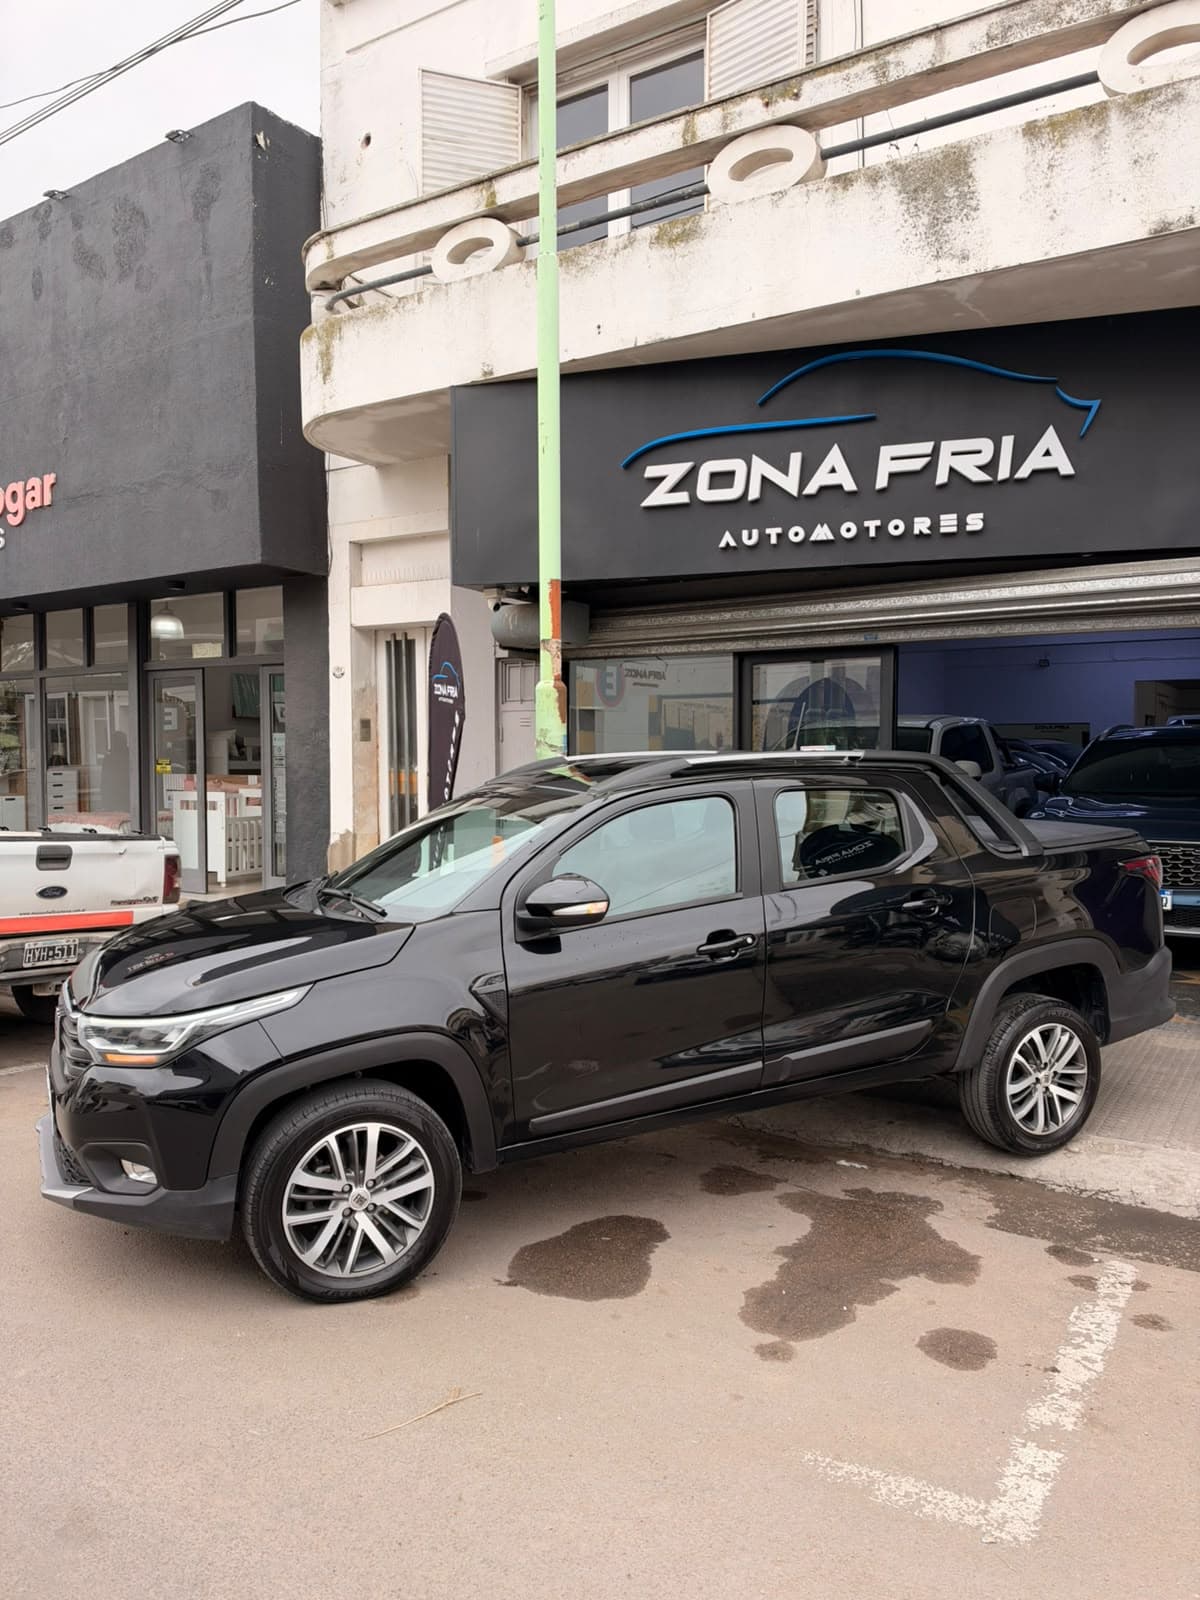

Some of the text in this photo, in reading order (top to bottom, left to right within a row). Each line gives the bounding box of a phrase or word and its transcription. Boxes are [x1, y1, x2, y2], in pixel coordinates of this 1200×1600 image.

[640, 424, 1076, 508] ZONA FRIA
[0, 472, 57, 527] gar
[718, 512, 985, 549] AUTOMOTORES
[25, 944, 75, 963] HYH 511
